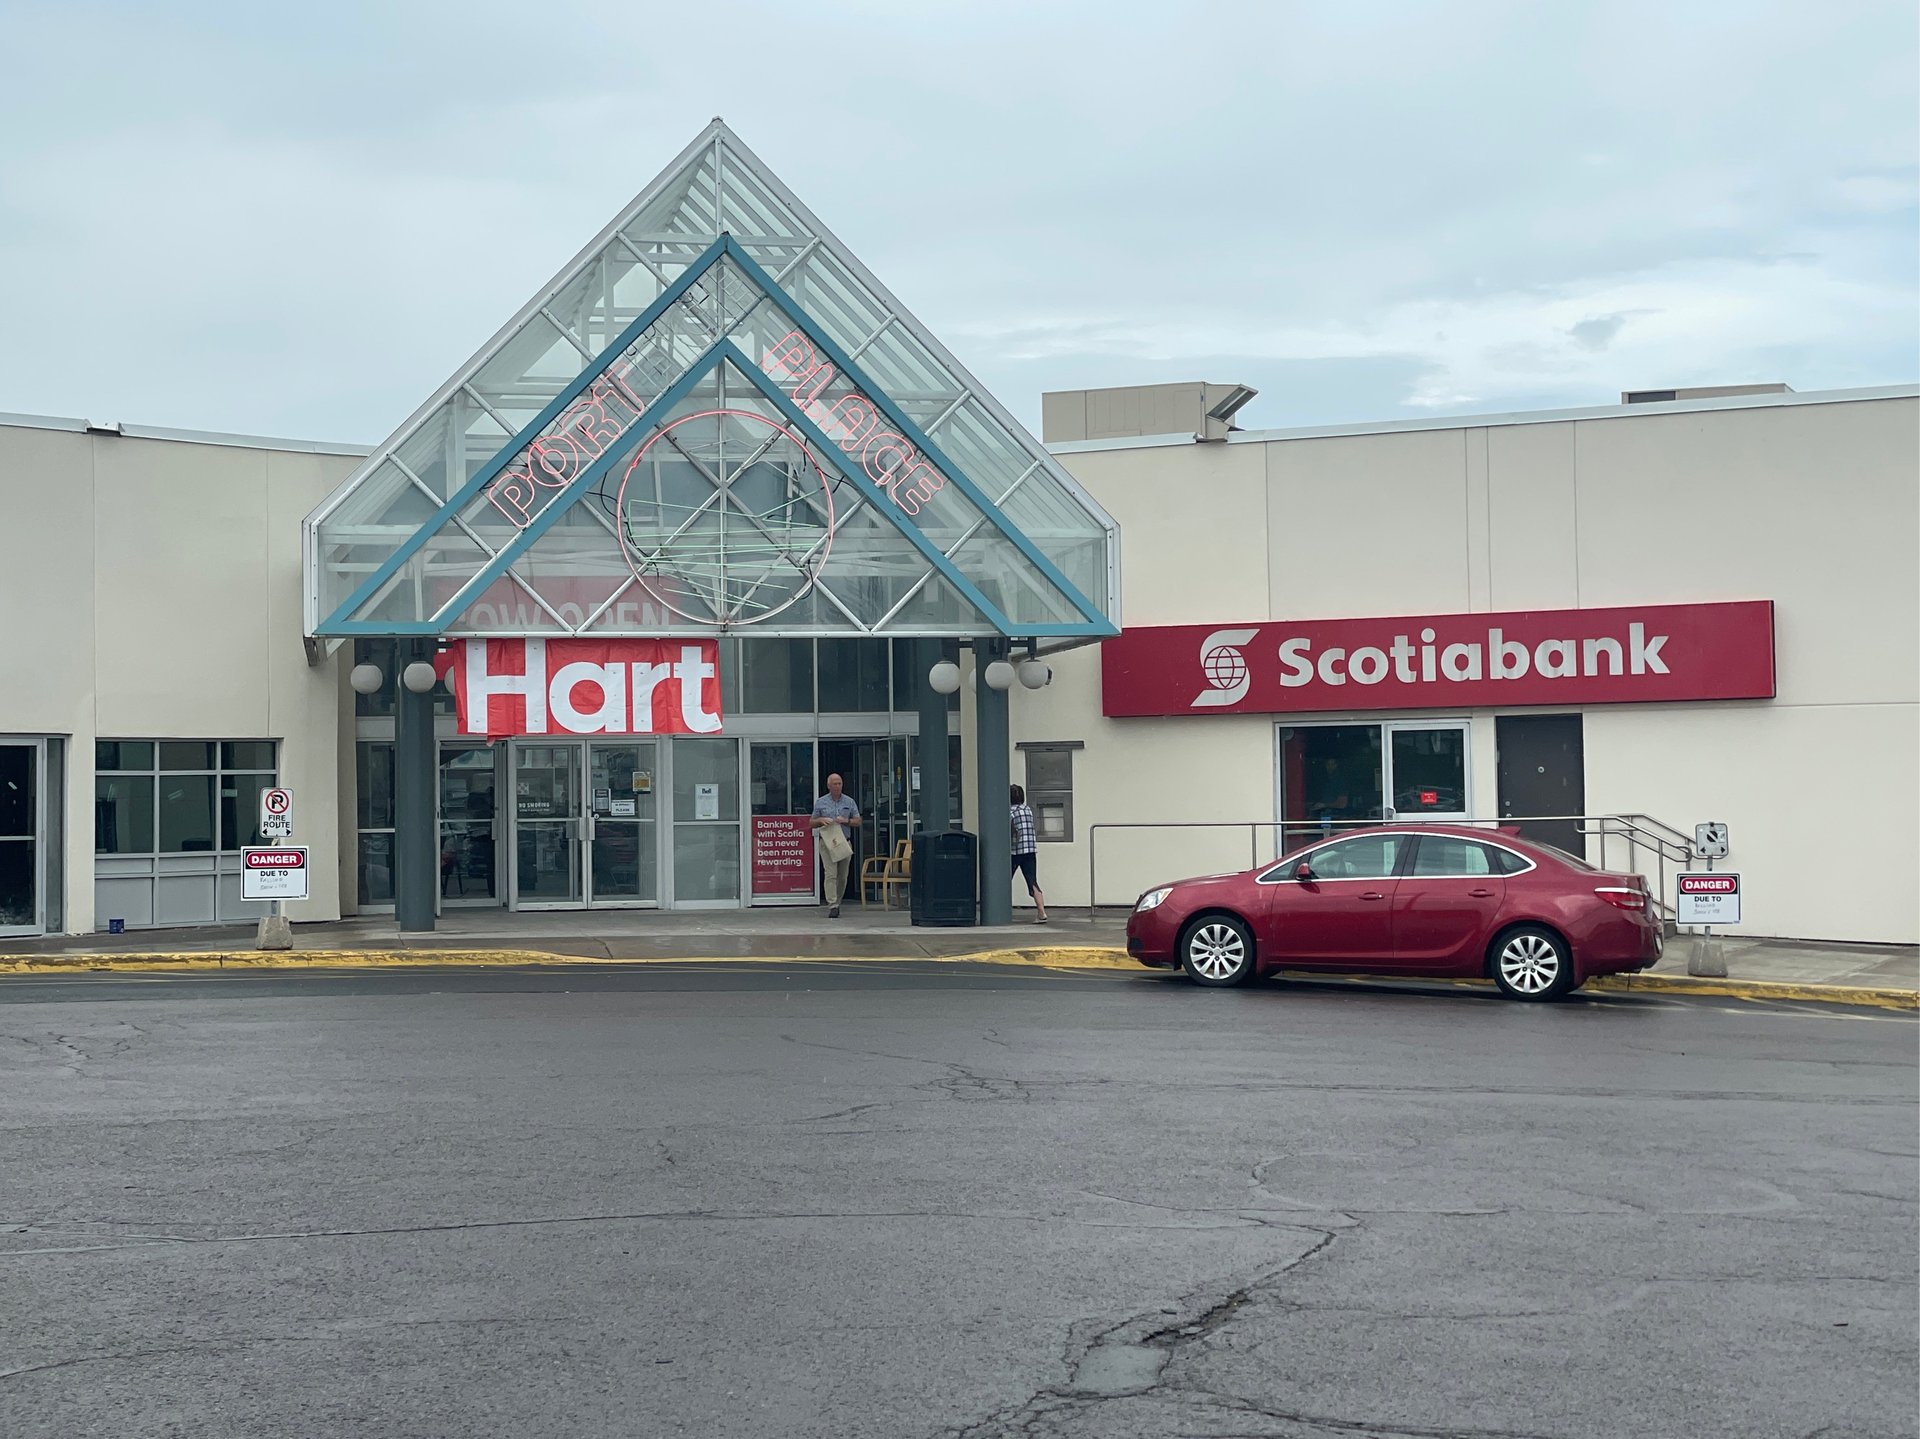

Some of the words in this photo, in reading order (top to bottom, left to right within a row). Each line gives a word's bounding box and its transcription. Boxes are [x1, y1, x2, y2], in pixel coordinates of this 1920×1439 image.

[763, 332, 944, 516] PLACE
[489, 363, 645, 528] PORT
[1278, 622, 1671, 688] Scotiabank
[465, 638, 723, 734] Hart
[268, 814, 286, 822] FIRE
[263, 821, 291, 829] ROUTE
[757, 821, 793, 829] Banking
[777, 830, 805, 838] Scotia
[757, 839, 773, 847] has
[757, 849, 780, 857] been
[251, 855, 297, 864] DANGER
[1685, 881, 1730, 889] DANGER
